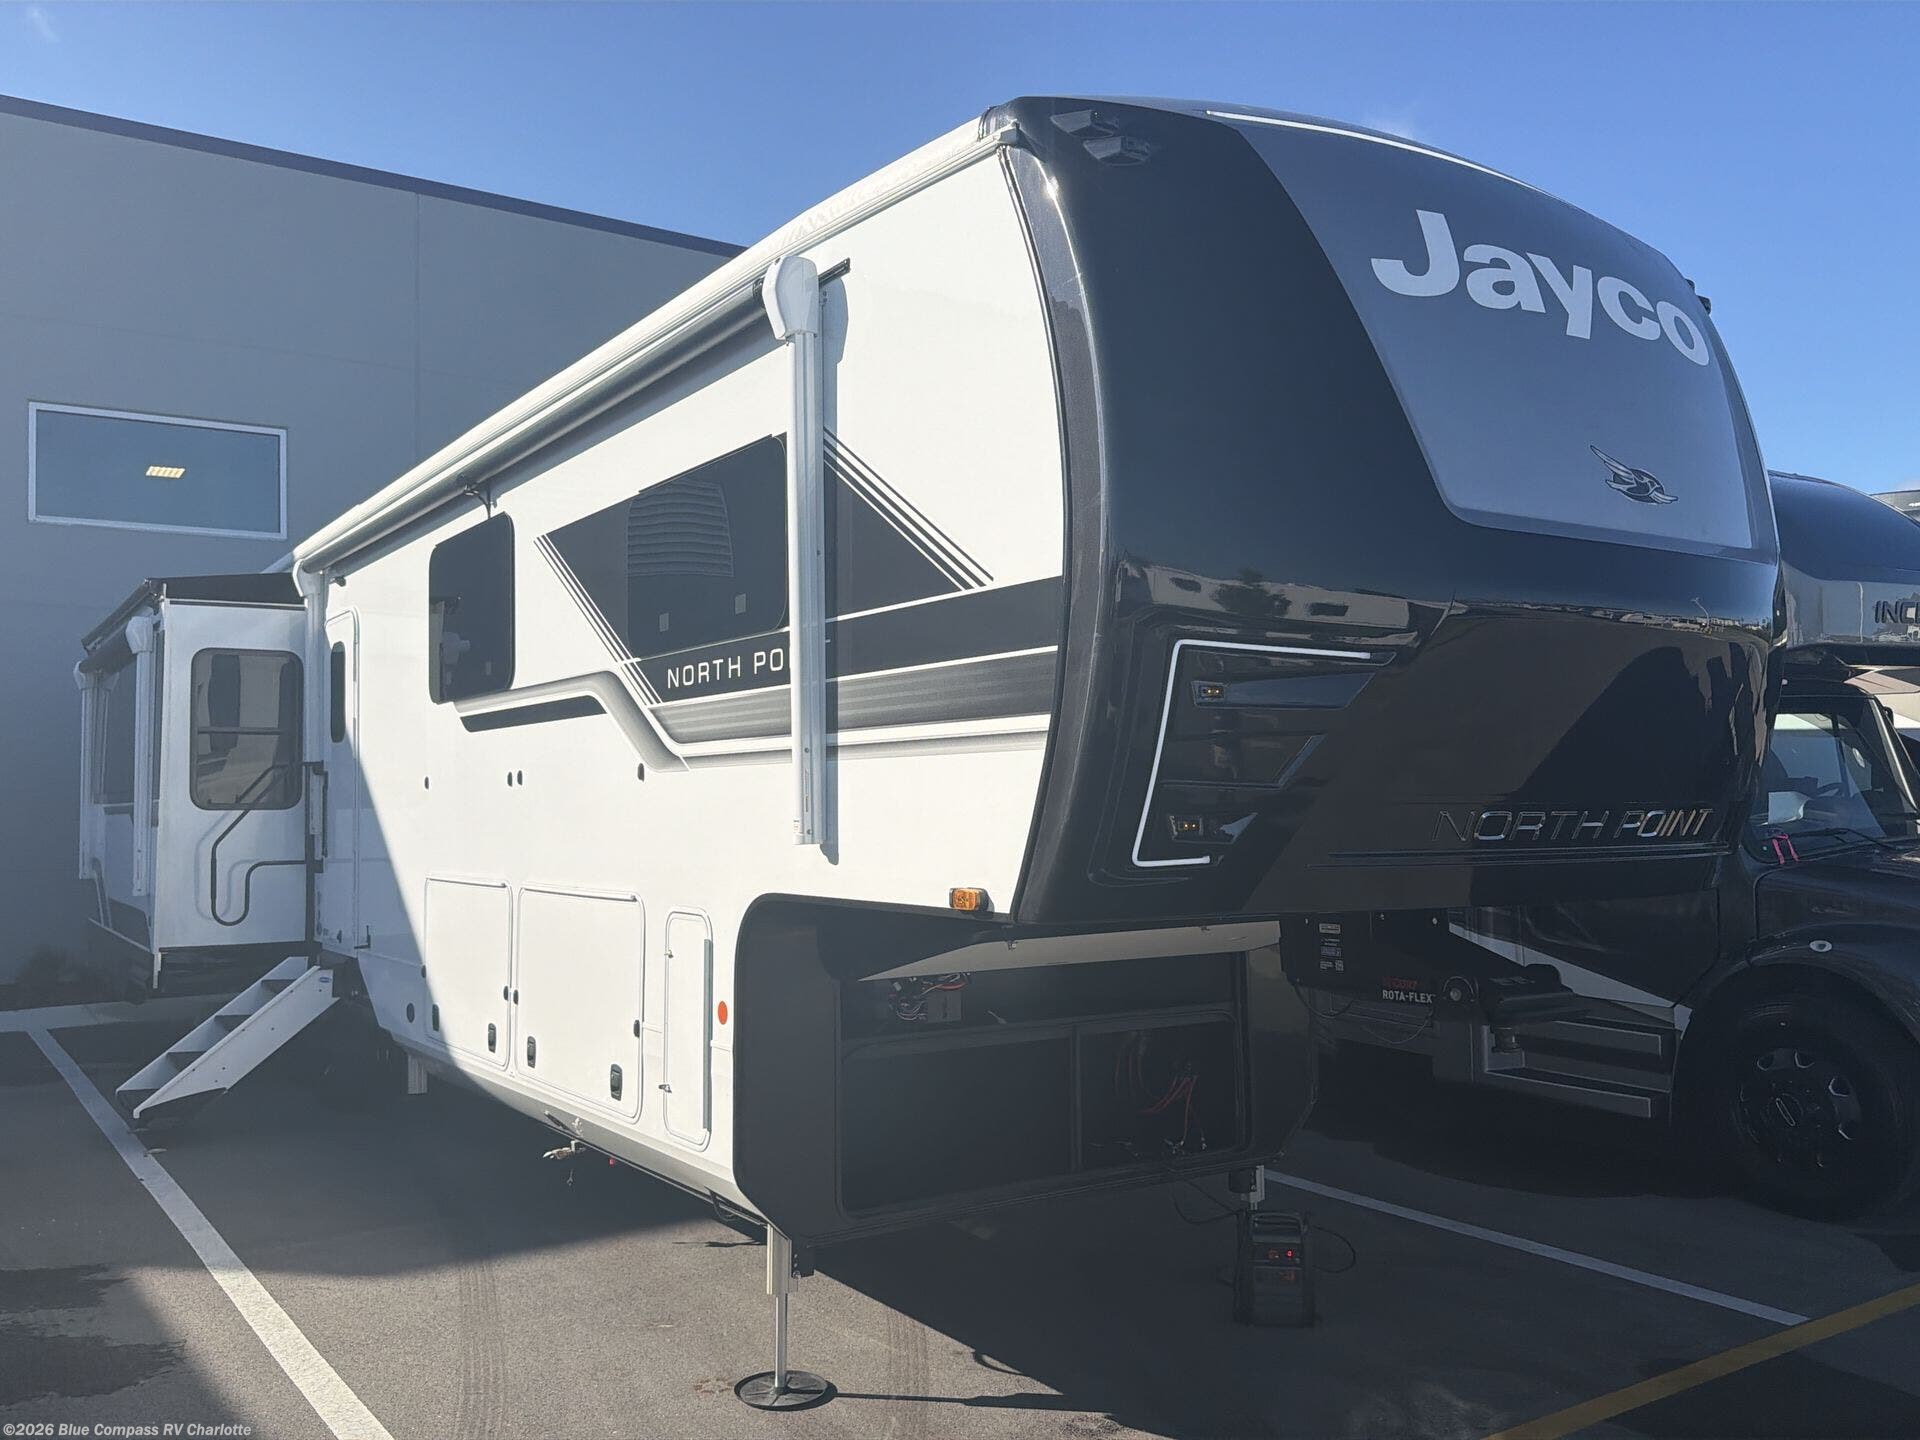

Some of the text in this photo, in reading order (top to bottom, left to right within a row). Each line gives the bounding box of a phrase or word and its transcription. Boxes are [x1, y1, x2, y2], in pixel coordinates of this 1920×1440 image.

[1370, 209, 1710, 367] Jayco
[667, 648, 791, 689] NORTH PO
[1432, 808, 1713, 841] NORTH POINT
